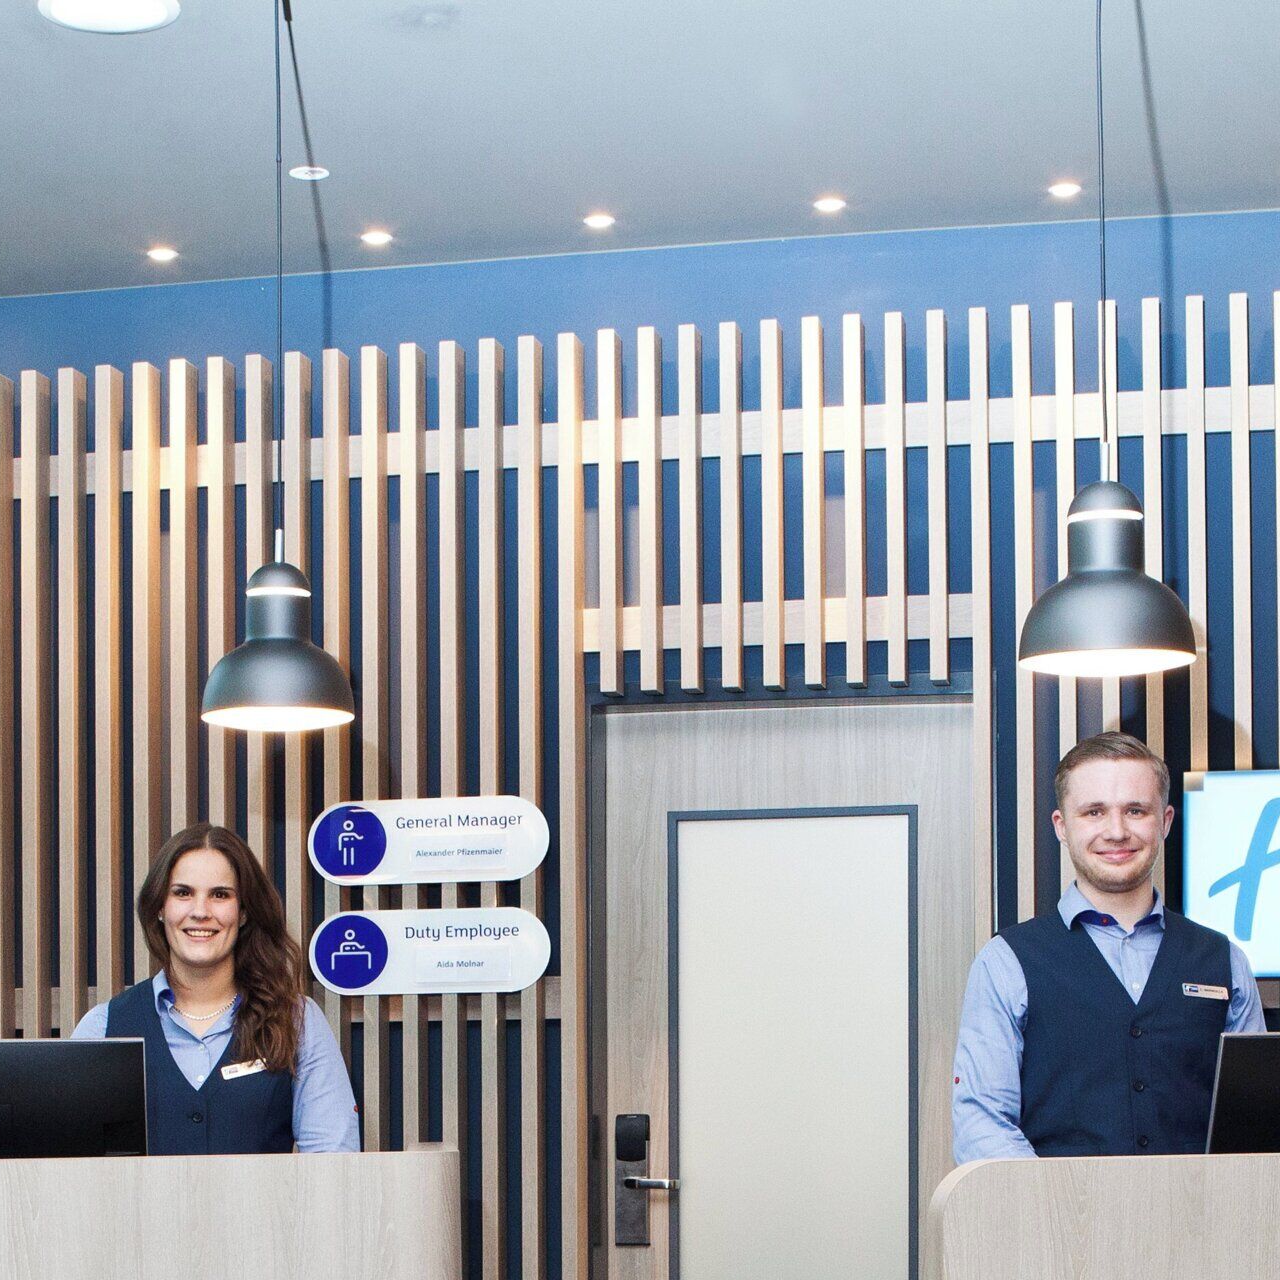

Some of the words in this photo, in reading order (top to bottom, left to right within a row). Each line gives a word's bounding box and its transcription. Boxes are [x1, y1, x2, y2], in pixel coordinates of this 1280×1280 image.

[395, 814, 452, 829] General
[457, 814, 523, 830] Manager
[415, 849, 455, 857] Alexander
[456, 848, 503, 856] Pfizenmaier
[404, 926, 440, 942] Duty
[445, 924, 520, 941] Employee
[456, 960, 485, 968] Molnar
